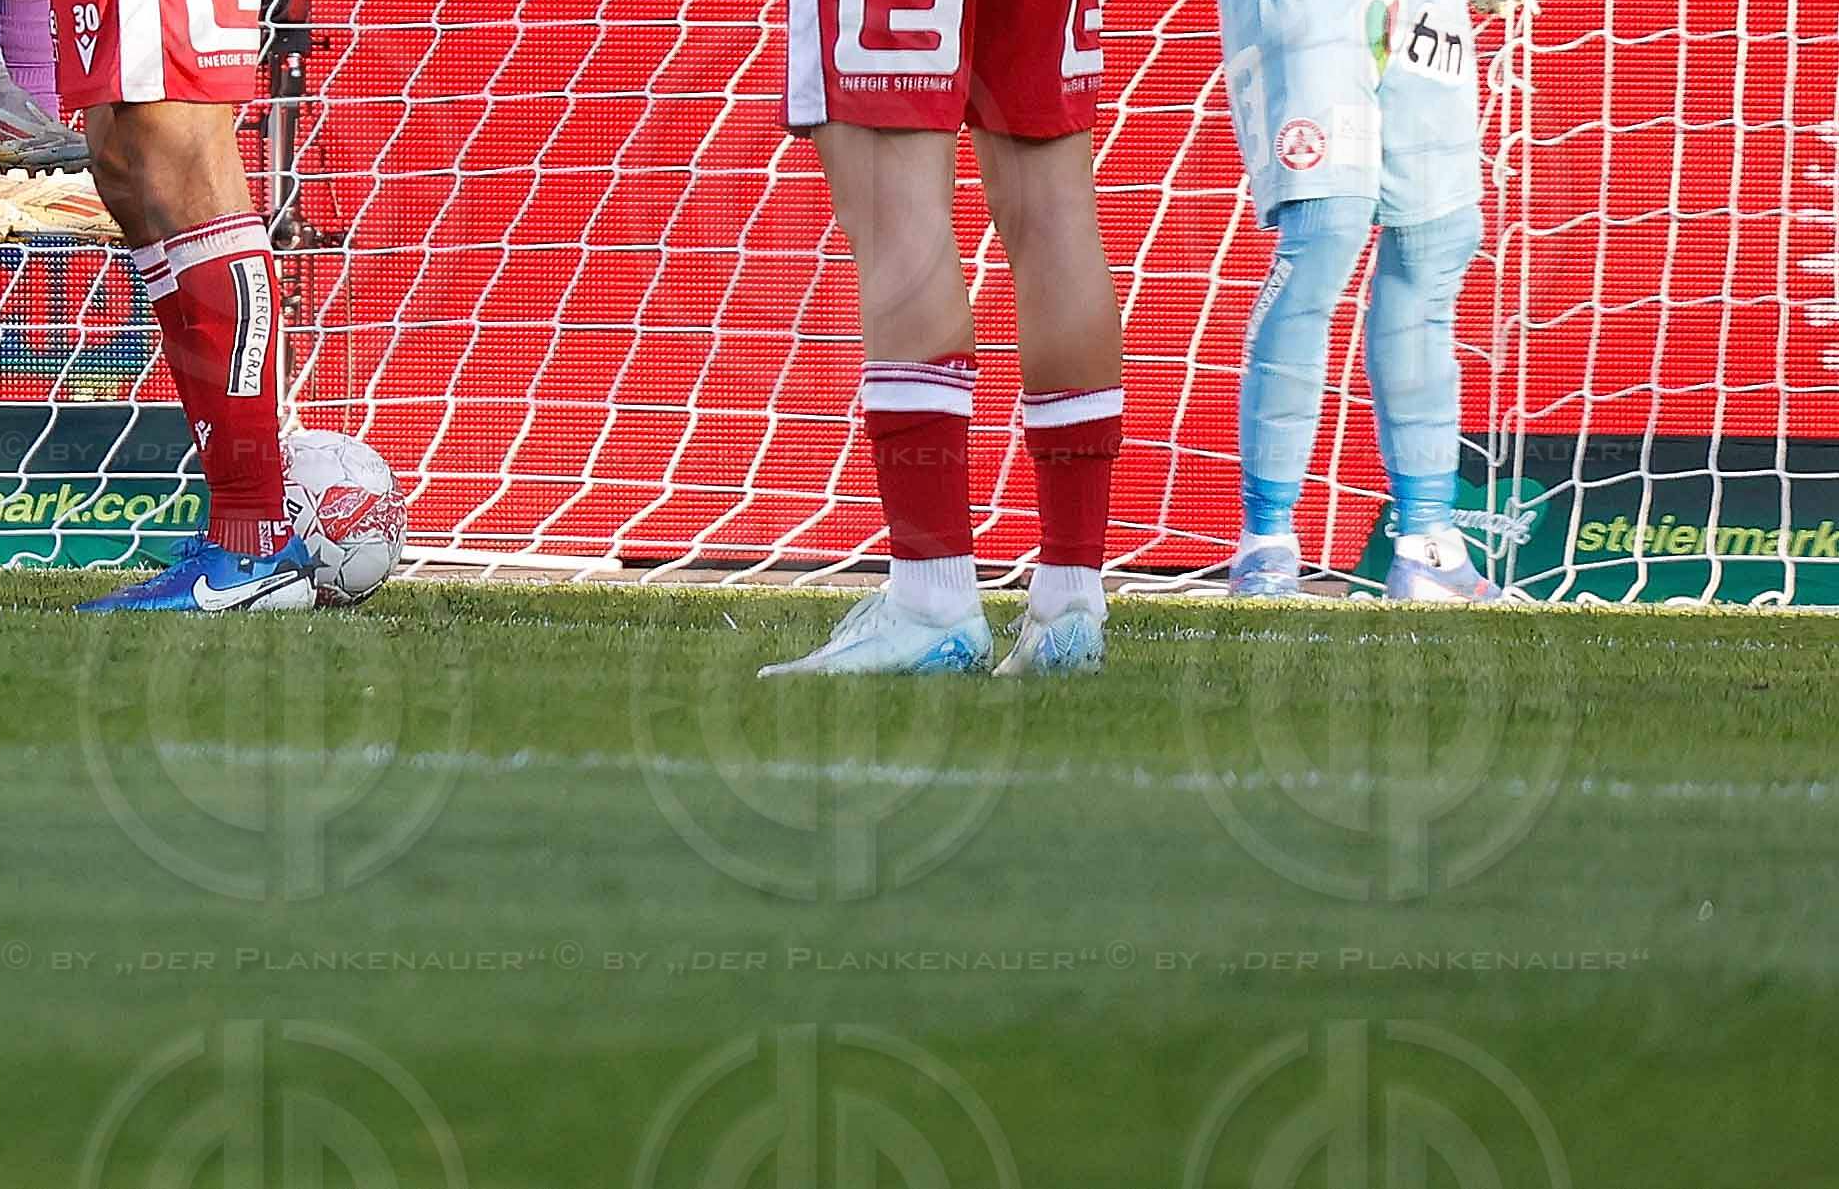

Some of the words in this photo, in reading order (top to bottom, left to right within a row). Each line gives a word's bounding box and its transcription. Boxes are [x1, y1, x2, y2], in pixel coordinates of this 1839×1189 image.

[72, 3, 100, 34] 30
[252, 272, 269, 341] ENERGIE
[244, 347, 262, 390] GRAZ
